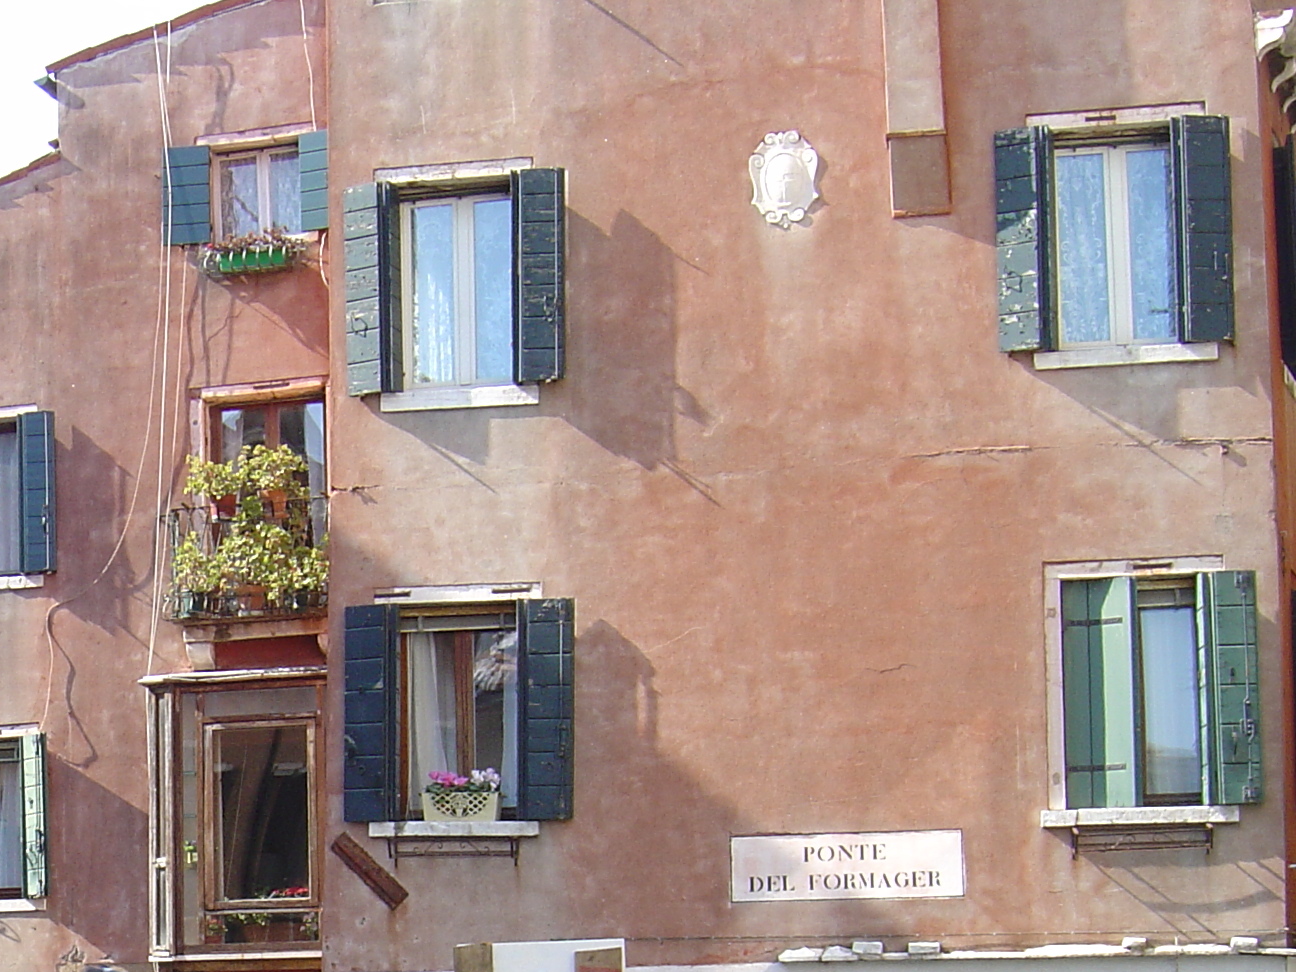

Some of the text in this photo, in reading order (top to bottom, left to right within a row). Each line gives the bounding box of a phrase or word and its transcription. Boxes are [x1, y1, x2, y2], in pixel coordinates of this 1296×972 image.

[803, 843, 887, 863] PONTE
[749, 870, 942, 893] DEL FORMAGER
